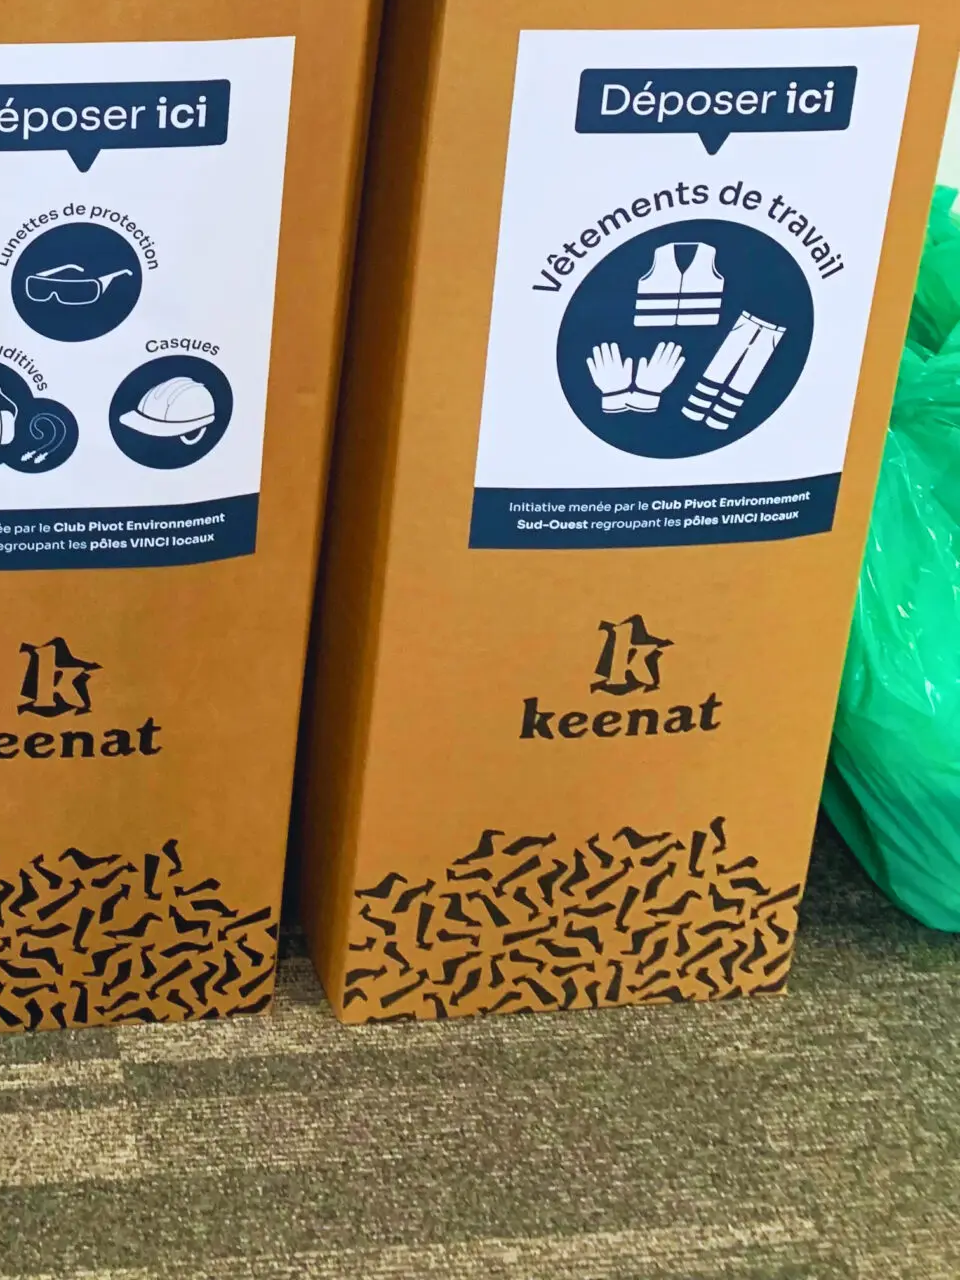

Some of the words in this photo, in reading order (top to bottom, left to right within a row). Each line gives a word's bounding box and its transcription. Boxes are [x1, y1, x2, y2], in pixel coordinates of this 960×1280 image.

[156, 96, 207, 129] ici
[600, 82, 777, 123] Déposer
[786, 81, 835, 114] ici
[62, 202, 86, 218] de
[90, 204, 159, 270] protection
[532, 182, 710, 293] Vêtements
[719, 181, 763, 210] de
[768, 194, 845, 280] travail
[145, 337, 220, 357] Casques
[509, 502, 566, 513] Initiative
[568, 501, 612, 512] menée
[614, 502, 635, 514] par
[638, 501, 649, 512] le
[651, 499, 682, 511] Club
[684, 498, 718, 509] Pivot
[719, 490, 811, 508] Environnement
[14, 525, 37, 537] par
[39, 522, 51, 534] le
[53, 521, 86, 533] Club
[88, 520, 124, 532] Pivot
[126, 512, 226, 531] Environnement
[517, 519, 588, 530] Sud-Ouest
[590, 518, 661, 531] regroupant
[664, 516, 682, 527] les
[683, 514, 719, 528] pôles
[721, 513, 758, 525] VINCI
[760, 509, 799, 522] locaux
[68, 538, 88, 550] les
[89, 537, 127, 551] pôles
[130, 536, 169, 549] VINCI
[172, 532, 215, 547] locaux
[519, 692, 723, 740] keenat
